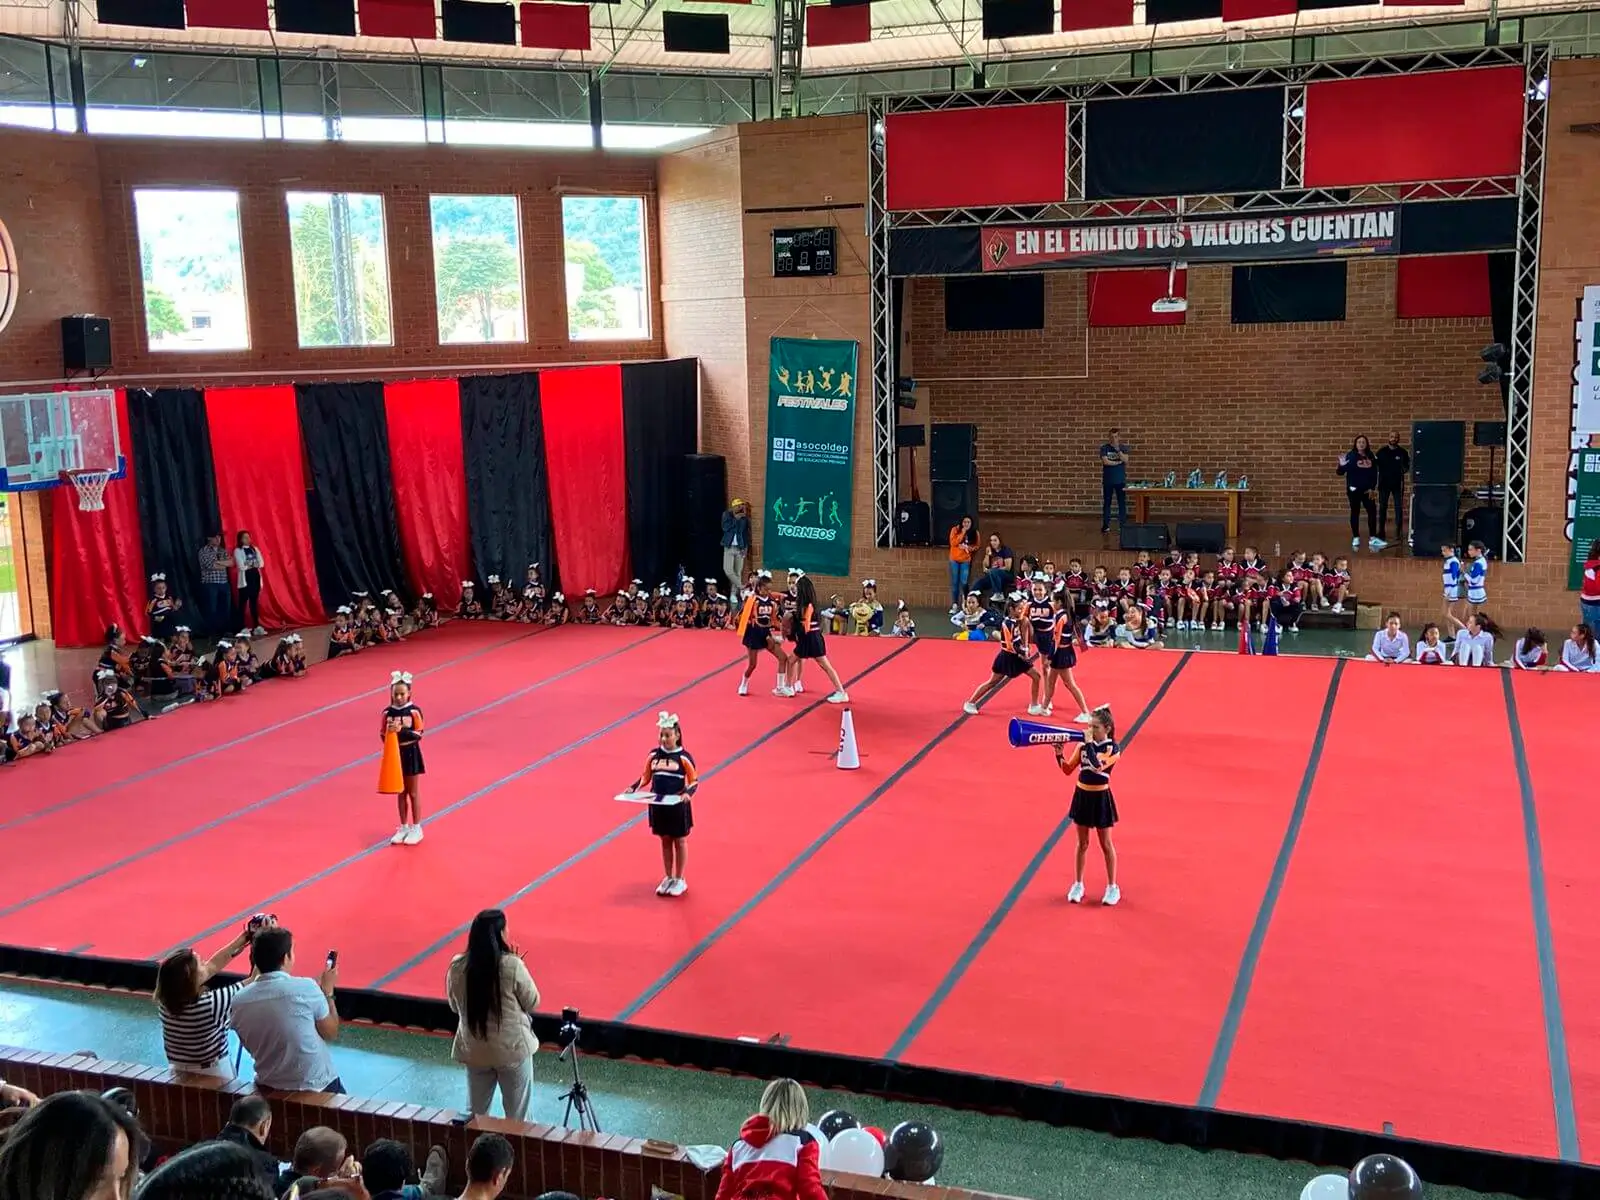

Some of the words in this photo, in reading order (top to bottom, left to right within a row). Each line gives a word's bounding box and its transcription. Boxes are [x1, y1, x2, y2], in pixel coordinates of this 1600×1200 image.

[1015, 230, 1040, 254] EN
[1045, 229, 1065, 253] EL
[1070, 226, 1139, 252] EMILIO
[1144, 224, 1186, 249] TUS
[1190, 217, 1286, 247] VALORES
[1291, 211, 1395, 242] CUENTAN
[777, 395, 848, 411] FESTIVALES
[796, 441, 849, 453] asocoldep
[777, 524, 836, 540] TORNEOS
[1028, 733, 1071, 743] CHEER
